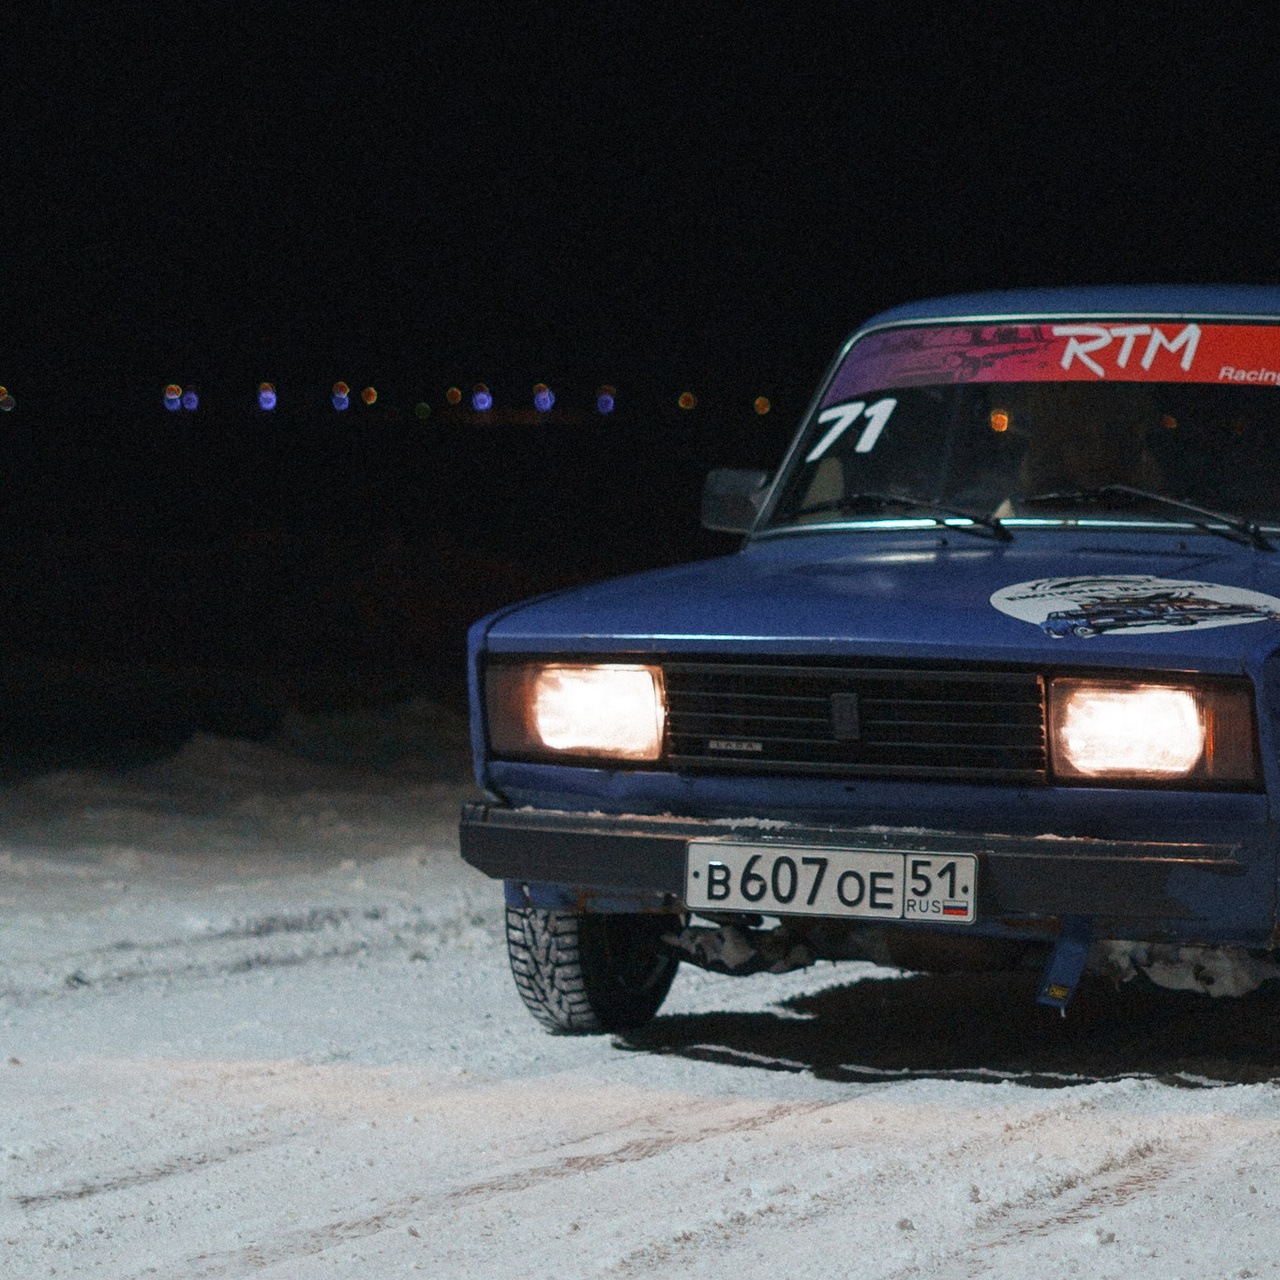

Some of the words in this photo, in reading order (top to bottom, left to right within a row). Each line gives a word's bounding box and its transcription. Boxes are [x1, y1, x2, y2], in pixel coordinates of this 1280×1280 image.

[1052, 324, 1201, 377] RTM
[806, 398, 897, 463] 71
[911, 860, 957, 898] 51
[907, 899, 941, 913] RUS
